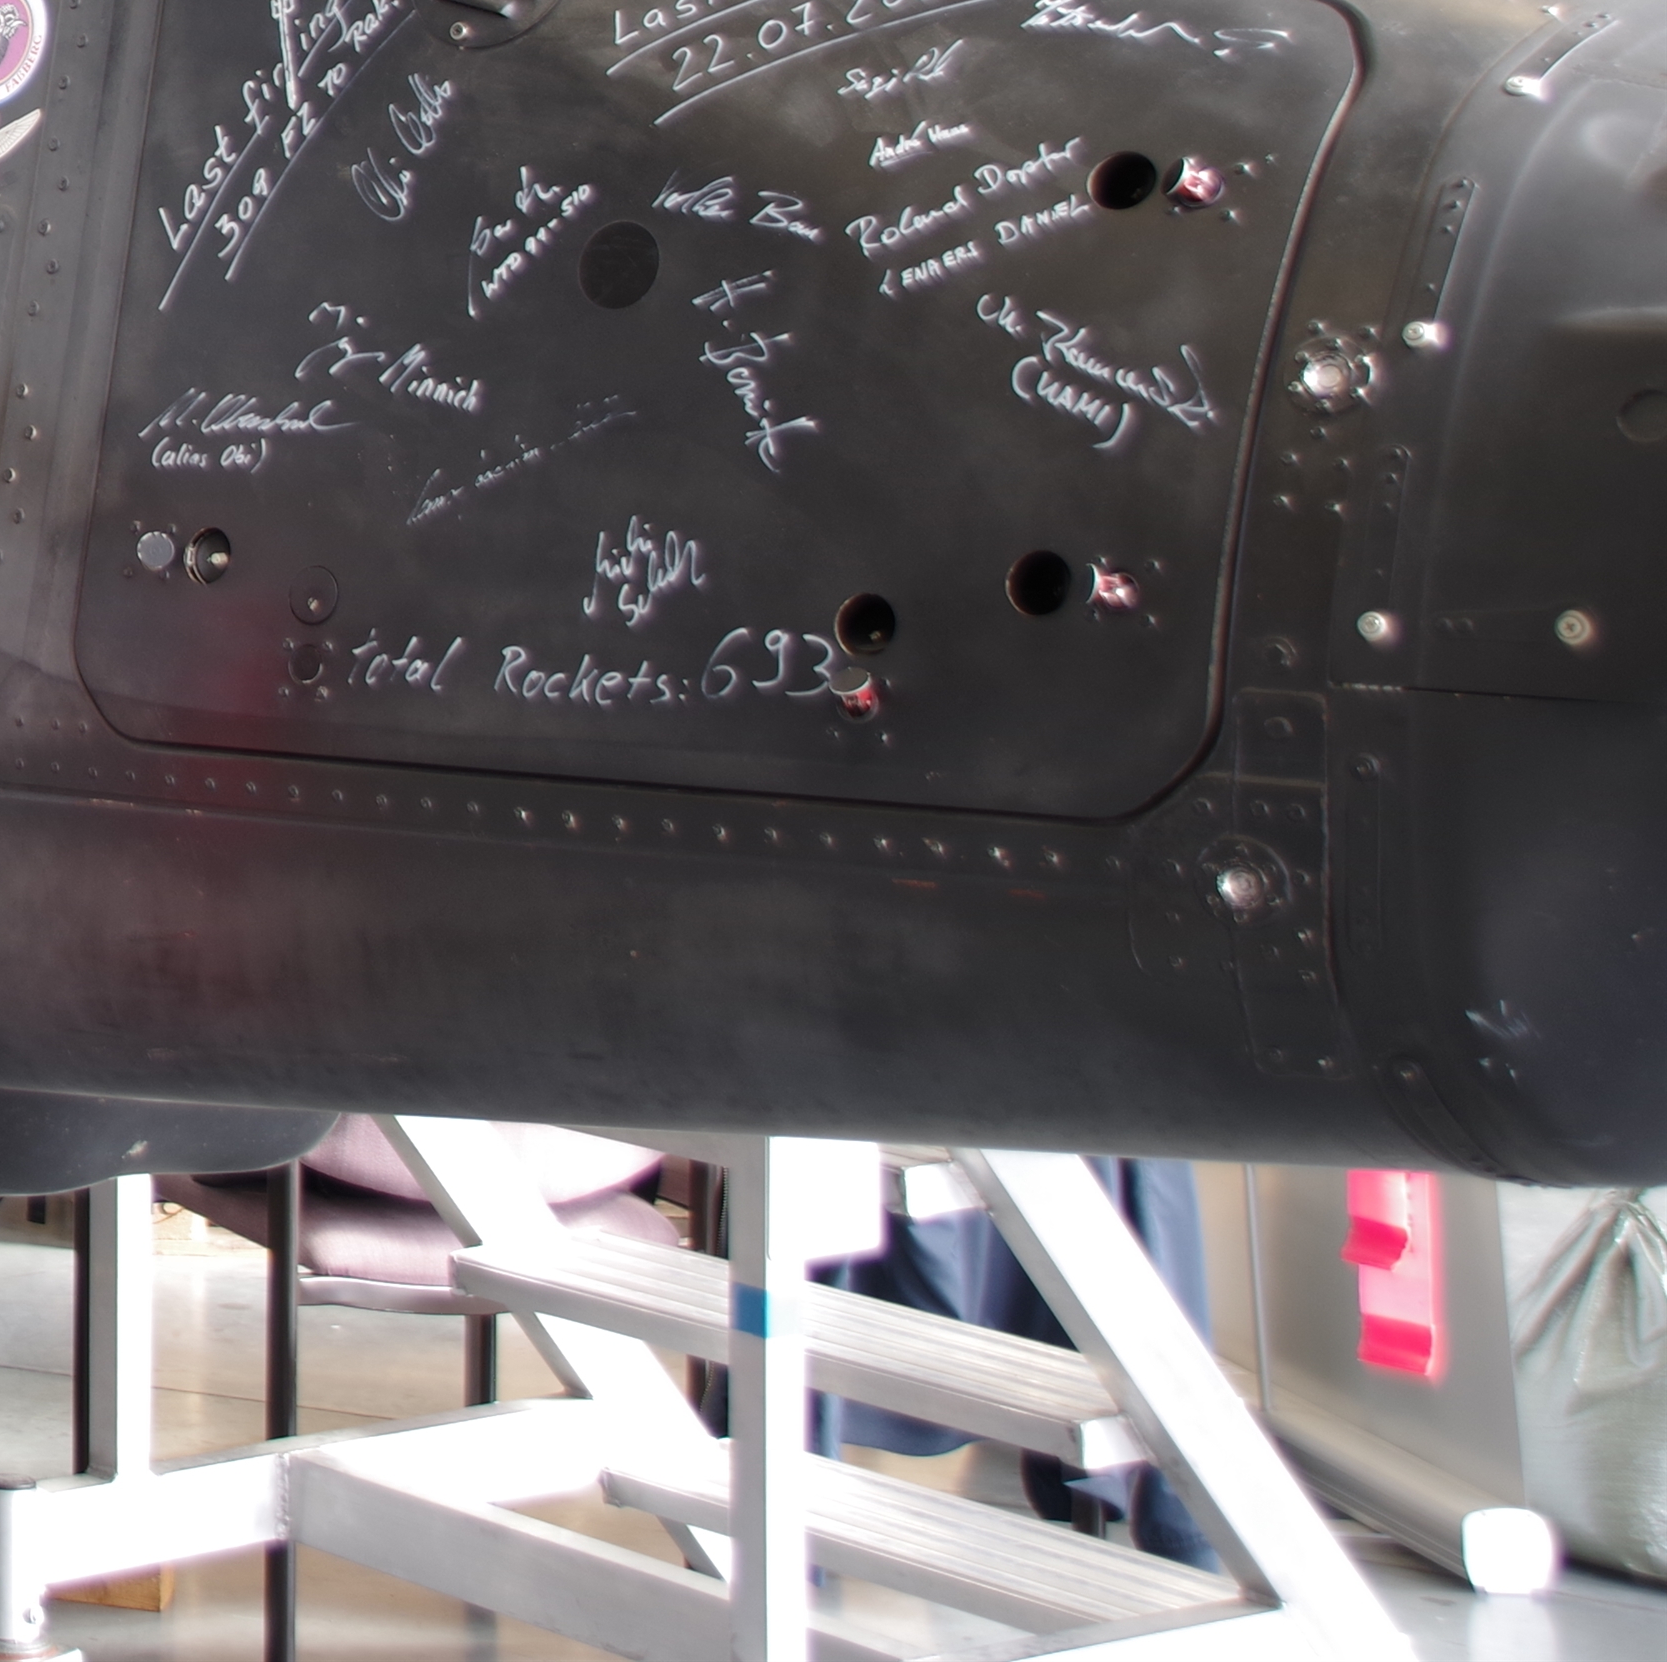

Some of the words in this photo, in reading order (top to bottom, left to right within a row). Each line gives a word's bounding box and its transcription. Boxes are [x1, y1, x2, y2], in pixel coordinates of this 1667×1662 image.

[158, 124, 238, 252] Last
[844, 184, 970, 257] Roland
[995, 195, 1092, 245] DANIEL
[494, 645, 691, 705] Rockets:
